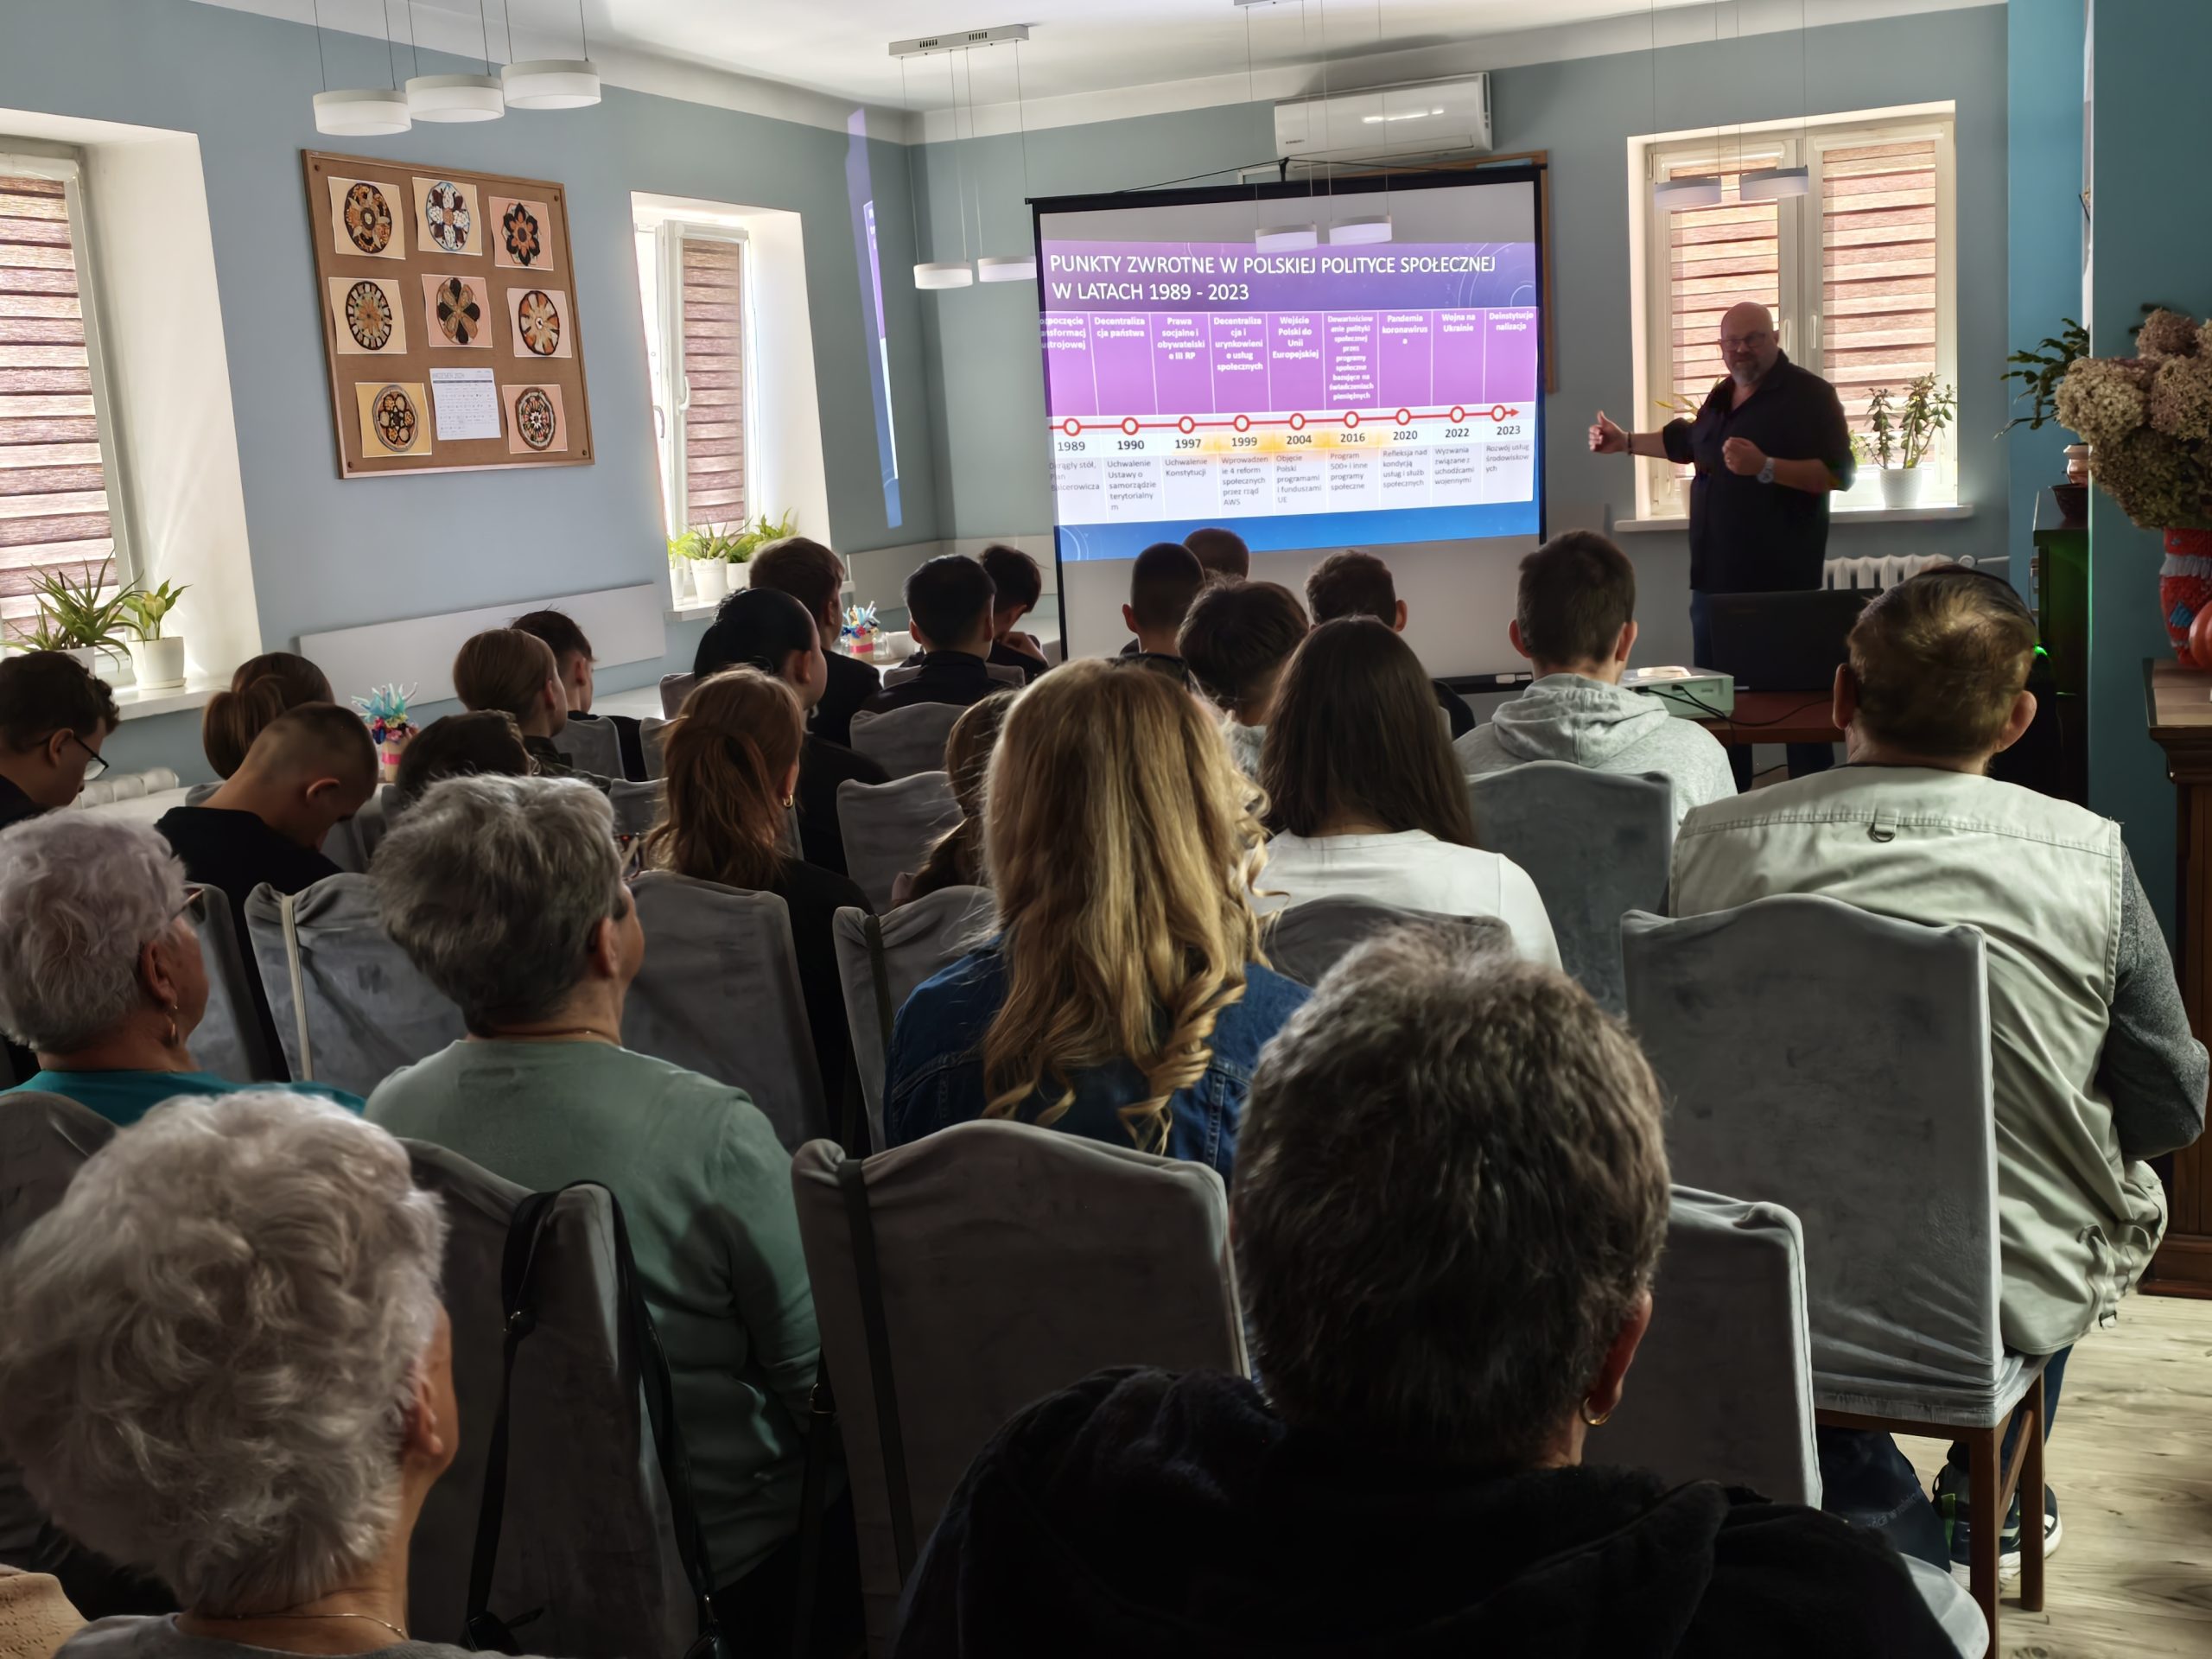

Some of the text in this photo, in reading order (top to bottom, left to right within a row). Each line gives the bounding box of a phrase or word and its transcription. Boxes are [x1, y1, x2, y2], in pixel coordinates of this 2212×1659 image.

[1050, 255, 1496, 274] PUNKTY ZWROTNE W POLSKIEJ POLITYCE SPOŁECZNEJ
[1052, 283, 1071, 300] W
[1077, 283, 1143, 300] LATACH
[1149, 283, 1191, 300] 1989
[1208, 283, 1249, 300] 2023
[1094, 316, 1145, 325] Decentraliza
[1214, 316, 1262, 325] Decentraliza
[1441, 314, 1465, 322] Wojna
[1489, 311, 1535, 321] Deinstytucjo
[1280, 316, 1310, 326] Wejście
[1382, 325, 1428, 334] koronawirus
[1443, 323, 1474, 332] Ukrainie
[1496, 321, 1527, 332] nalizacja
[1096, 328, 1145, 339] cja państwa
[1162, 328, 1195, 338] socjalne
[1230, 328, 1243, 338] cja
[1157, 340, 1205, 350] obywatelski
[1287, 338, 1304, 346] Unii
[1273, 349, 1319, 359] Europejskiej
[1445, 429, 1470, 438] 2022
[1497, 425, 1521, 435] 2023
[1287, 435, 1313, 445] 2004
[1340, 433, 1365, 442] 2016
[1393, 430, 1418, 441] 2020
[1058, 442, 1086, 451] 1989
[1117, 440, 1145, 450] 1990
[1175, 439, 1202, 448] 1997
[1232, 437, 1258, 447] 1999
[1435, 447, 1470, 455] Wyzwania
[1221, 455, 1268, 465] Wprowadzen
[1276, 454, 1302, 463] Objęcie
[1049, 461, 1077, 470] Orągły
[1108, 471, 1136, 480] Ustawy
[1166, 468, 1206, 477] Konstytucji
[1331, 473, 1364, 481] programy
[1223, 477, 1266, 486] społecznych
[1277, 474, 1320, 484] programami
[1109, 480, 1156, 490] samorządzie
[1281, 485, 1322, 493] funduszami
[1243, 487, 1259, 496] rząd
[1109, 492, 1154, 501] terytorialny
